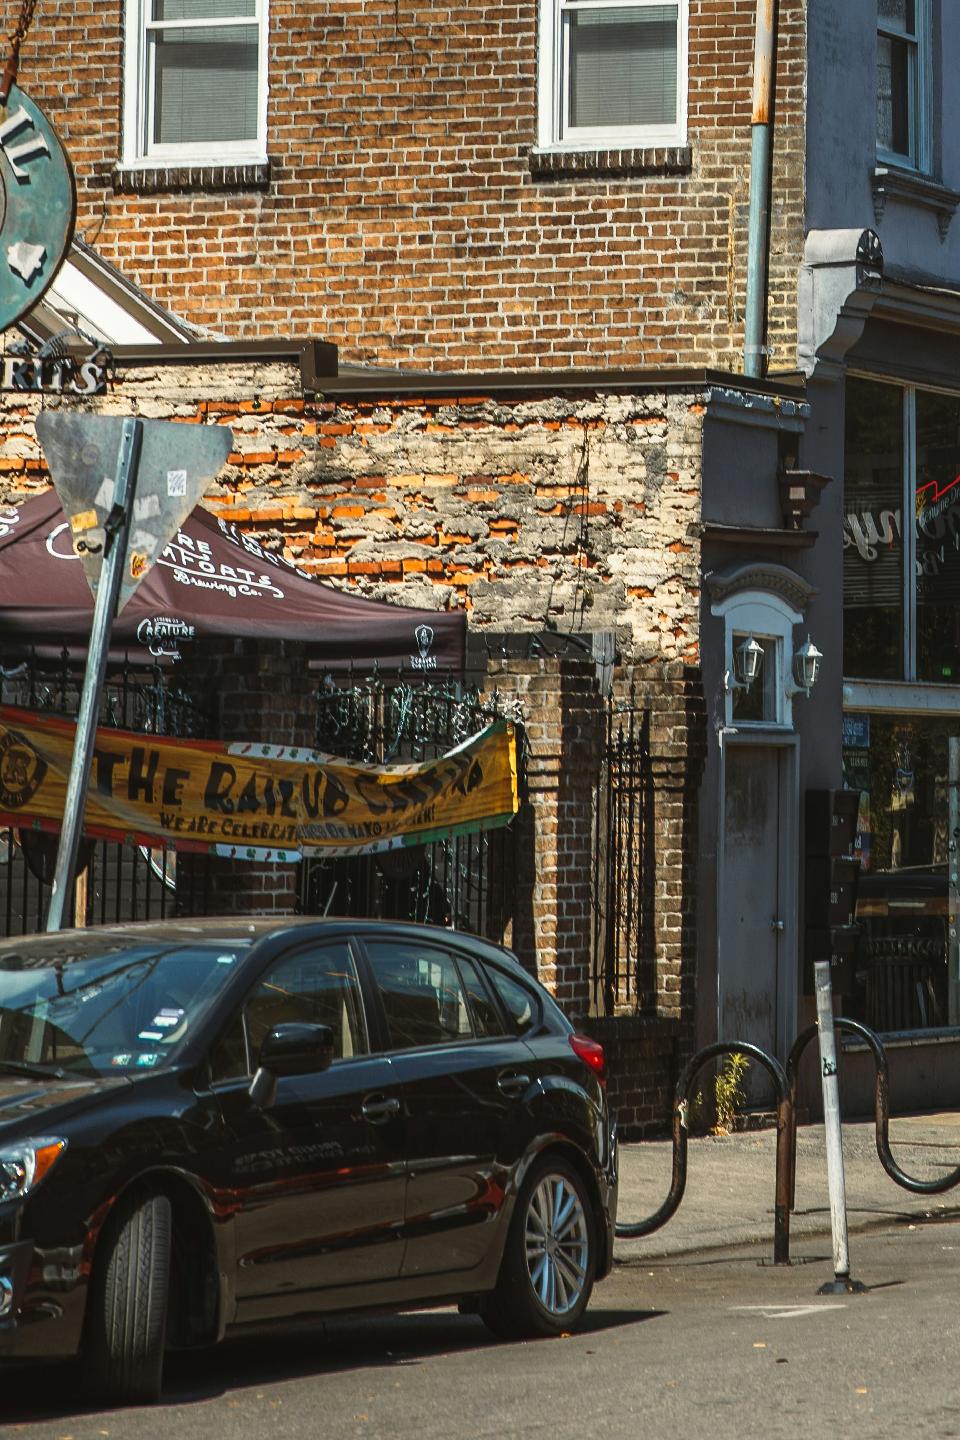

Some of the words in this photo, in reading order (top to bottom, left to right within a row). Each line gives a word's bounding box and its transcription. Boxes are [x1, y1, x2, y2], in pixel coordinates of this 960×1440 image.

[173, 568, 237, 597] Brewing
[137, 618, 195, 641] CREATURE
[94, 746, 191, 806] THE
[160, 811, 184, 832] WE
[187, 815, 217, 834] ARE
